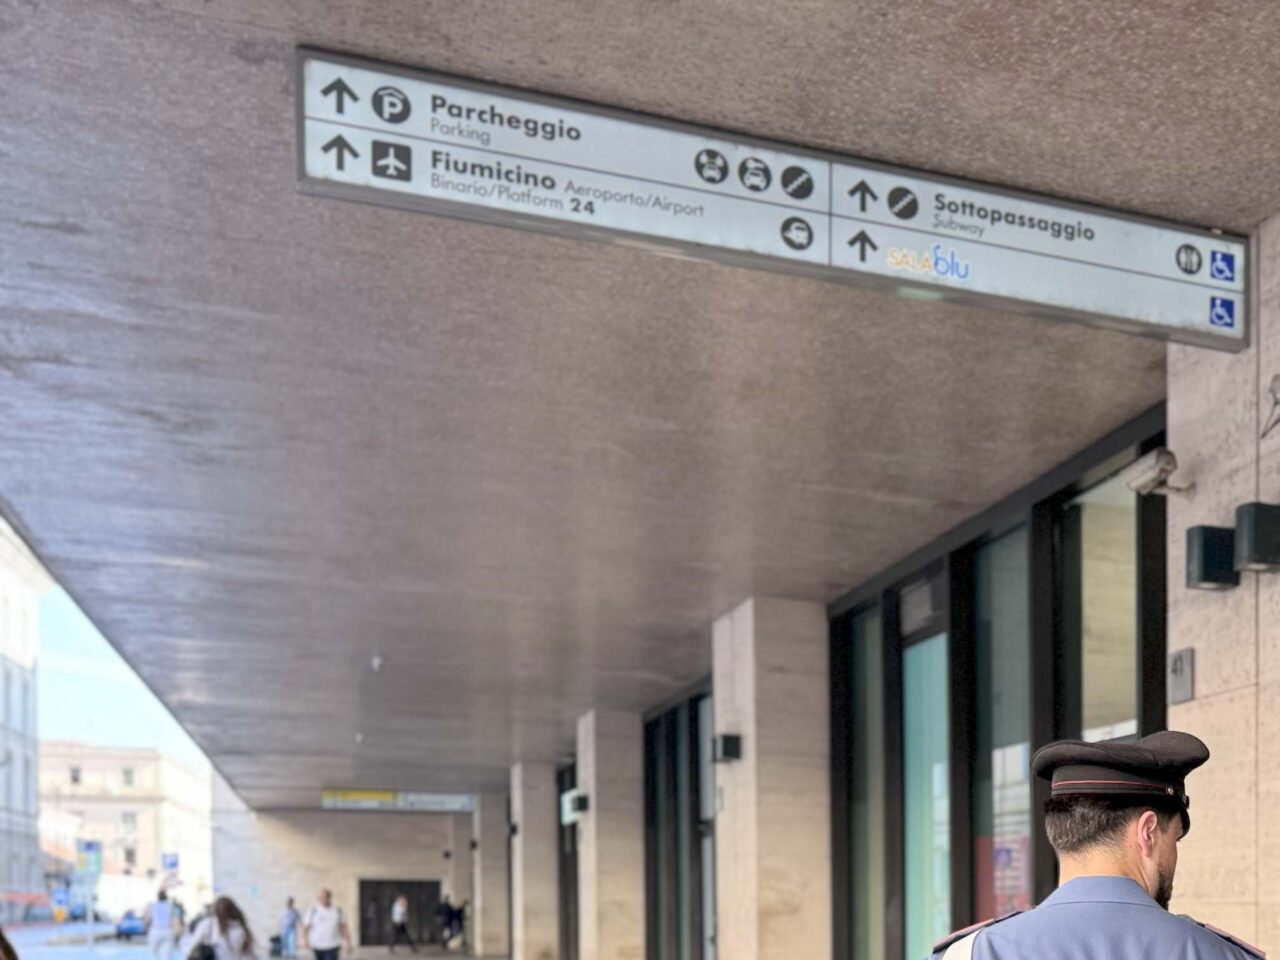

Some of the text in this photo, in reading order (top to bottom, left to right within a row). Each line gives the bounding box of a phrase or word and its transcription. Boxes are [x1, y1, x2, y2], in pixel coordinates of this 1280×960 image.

[430, 117, 492, 146] Parking
[431, 94, 582, 141] Parcheggio
[431, 150, 705, 217] Fiumicino Aeroporto/Airport
[431, 172, 596, 215] Binario/Platform 24
[932, 212, 986, 238] Subway
[934, 193, 1096, 241] Sottopassaggio
